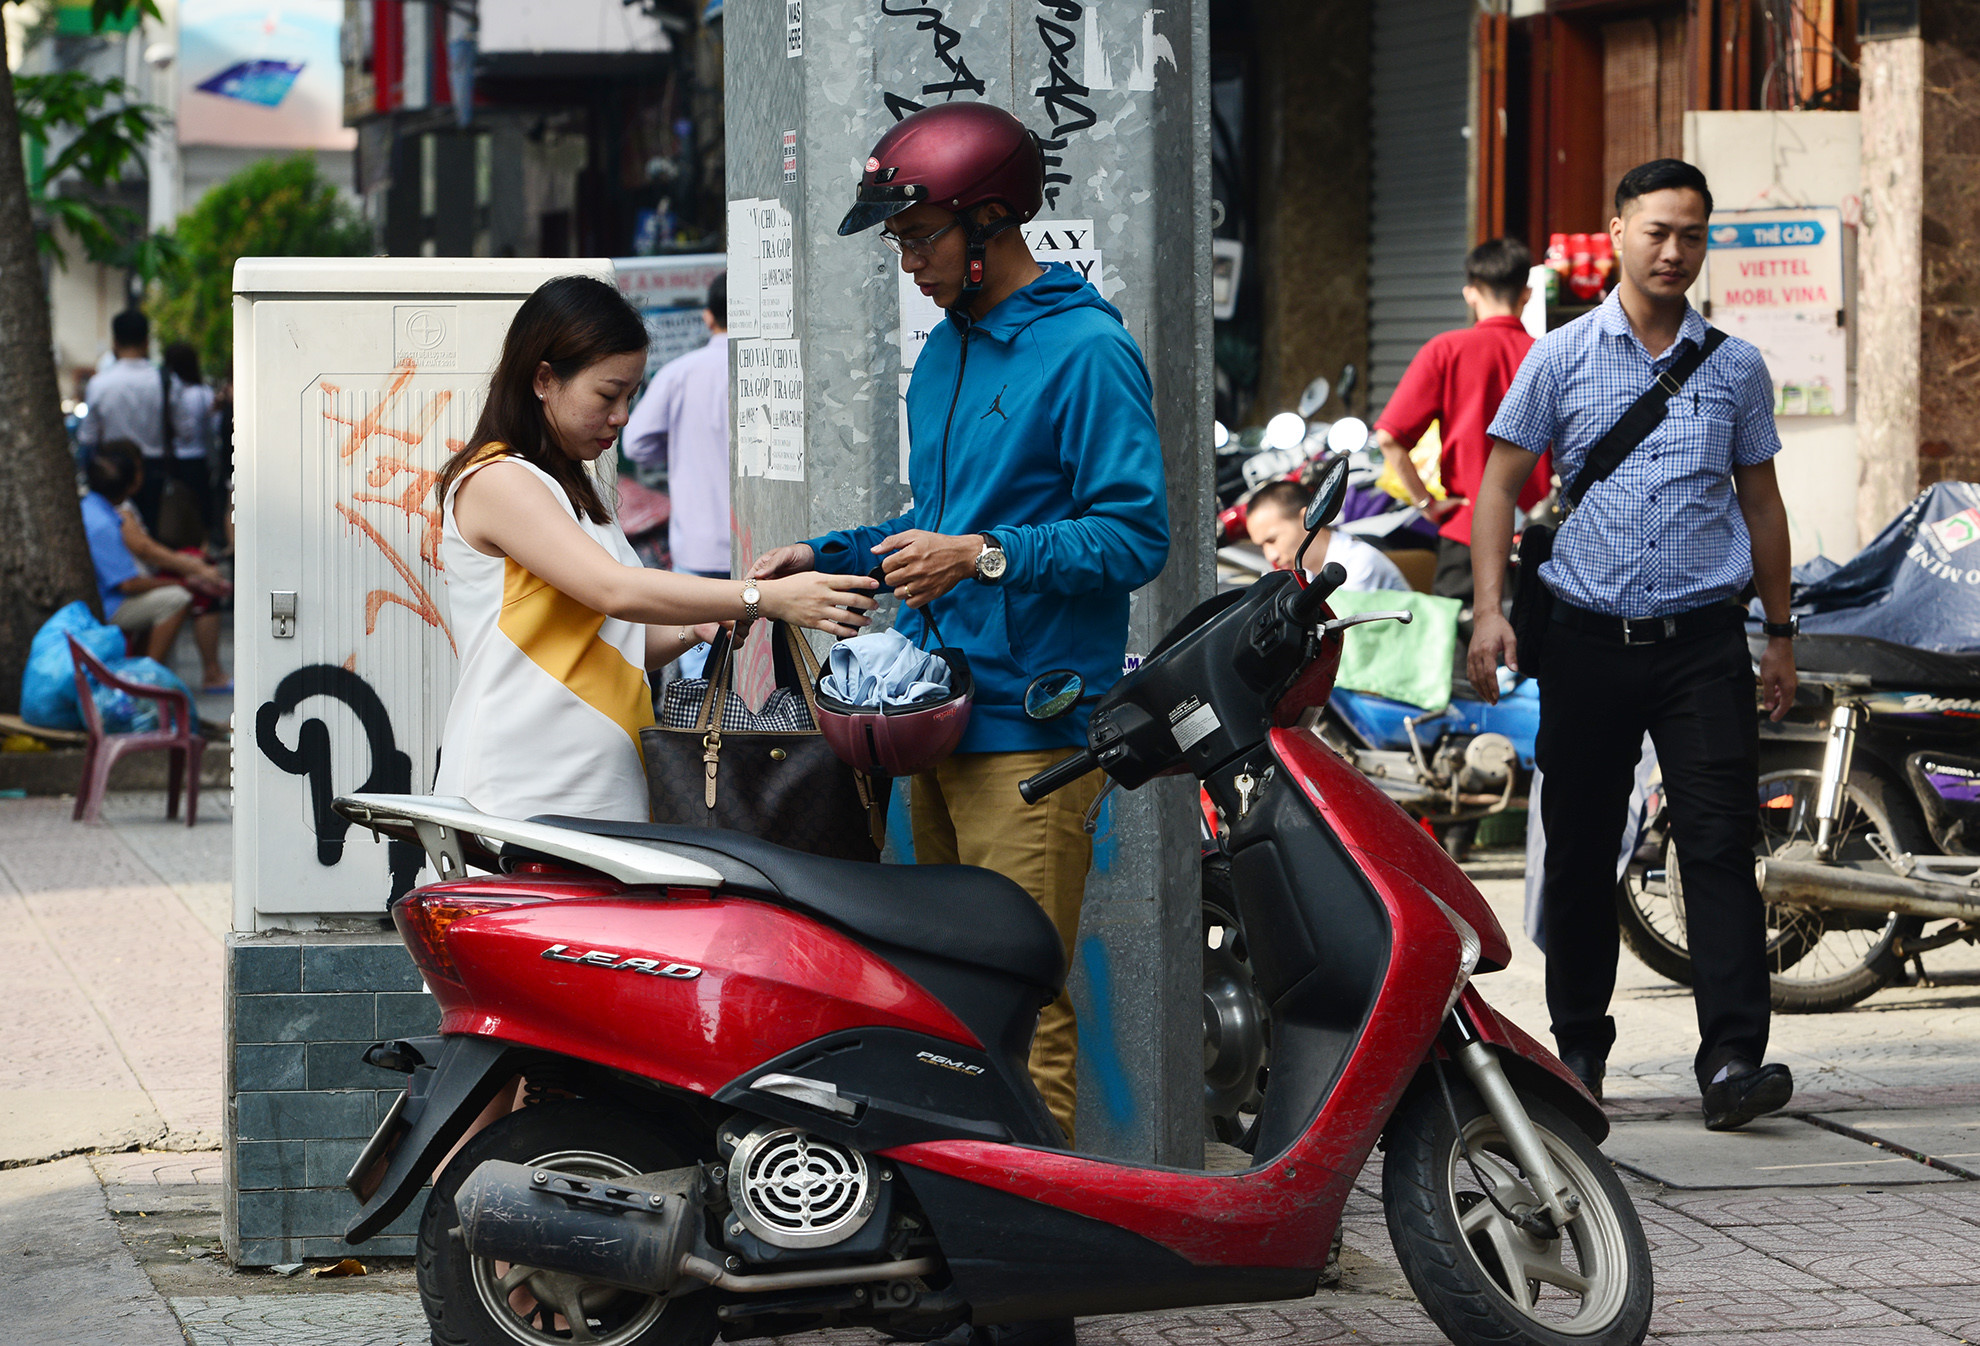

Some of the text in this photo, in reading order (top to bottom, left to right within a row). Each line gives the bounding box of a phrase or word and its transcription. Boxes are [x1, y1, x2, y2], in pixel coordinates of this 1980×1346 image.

[760, 209, 776, 229] CHO
[1739, 259, 1811, 277] VIETTEL
[1781, 285, 1829, 303] VINA
[738, 347, 770, 368] CHO VAY
[772, 348, 799, 369] CHO VA
[540, 943, 703, 981] LEAD
